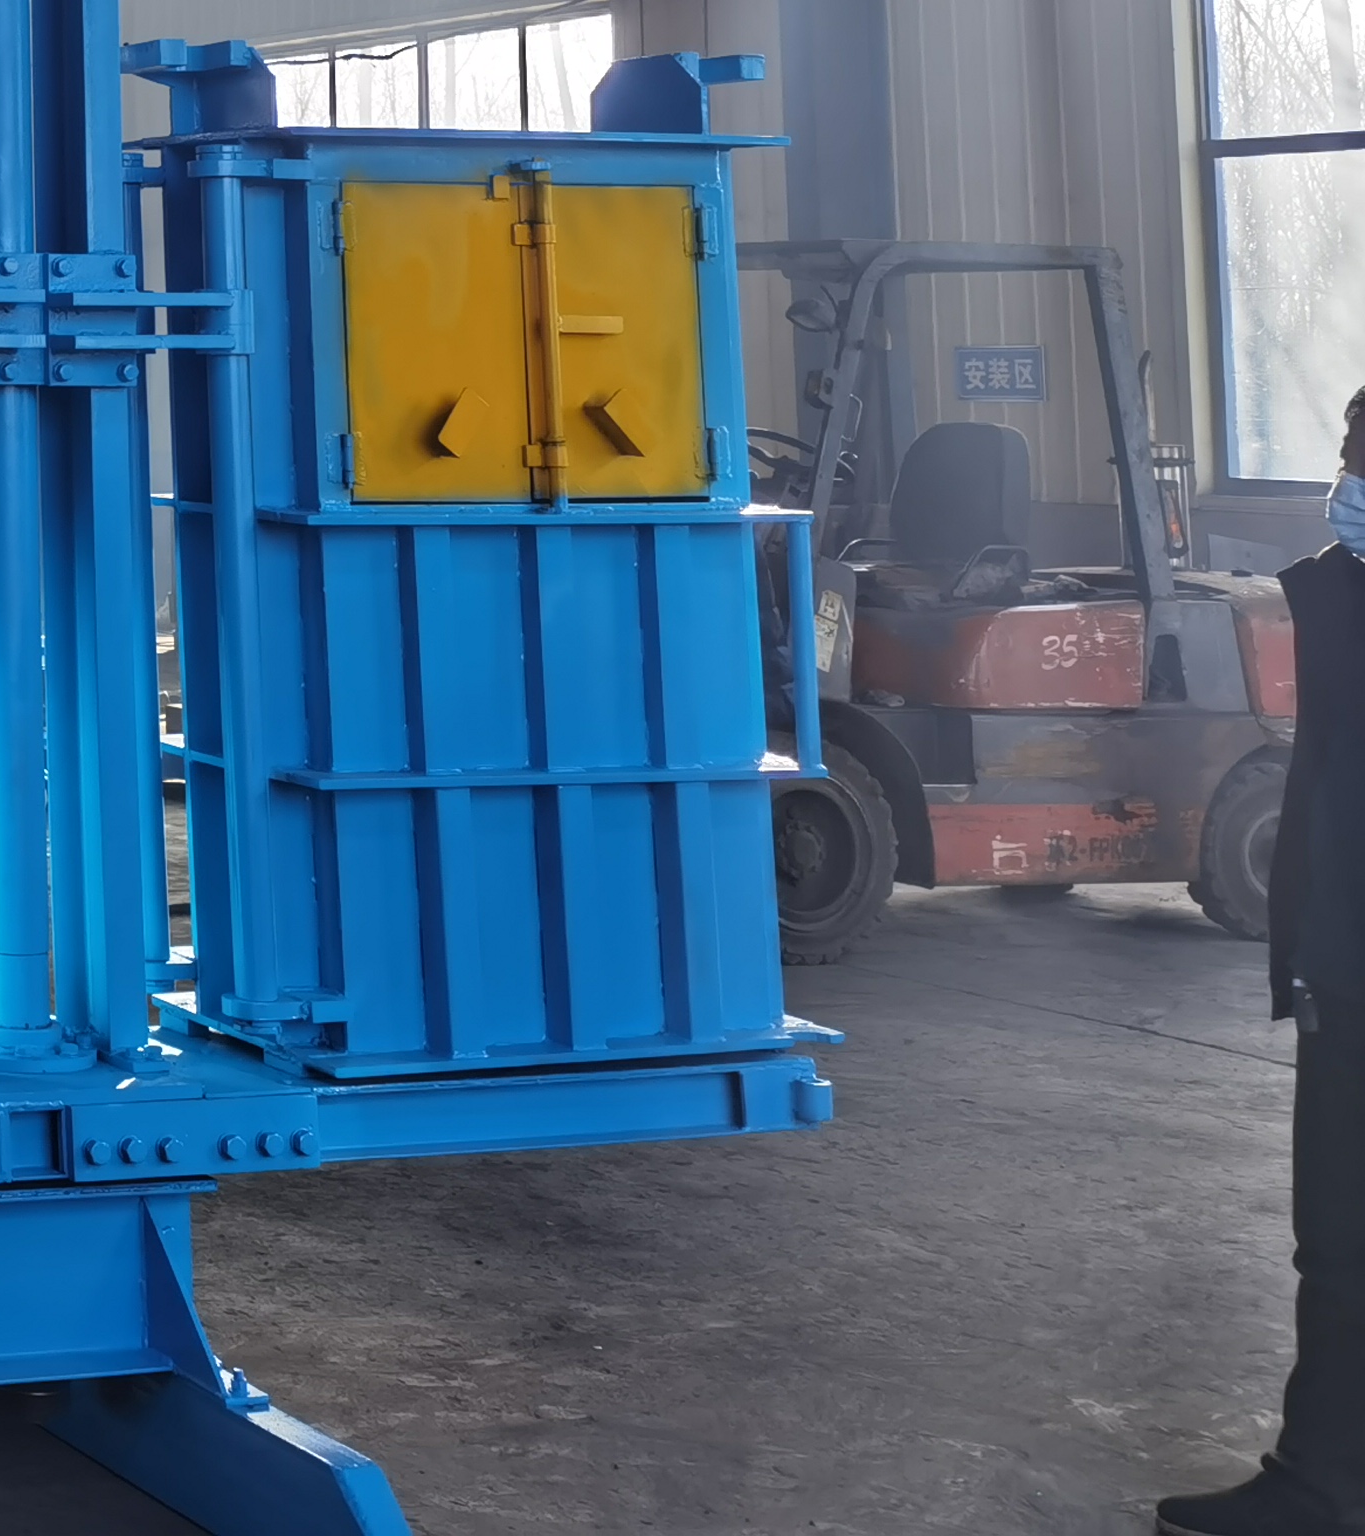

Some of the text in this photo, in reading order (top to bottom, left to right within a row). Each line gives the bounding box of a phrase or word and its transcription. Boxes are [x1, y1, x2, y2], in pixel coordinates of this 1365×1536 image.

[963, 357, 1037, 391] 安装区
[1040, 633, 1080, 671] 35
